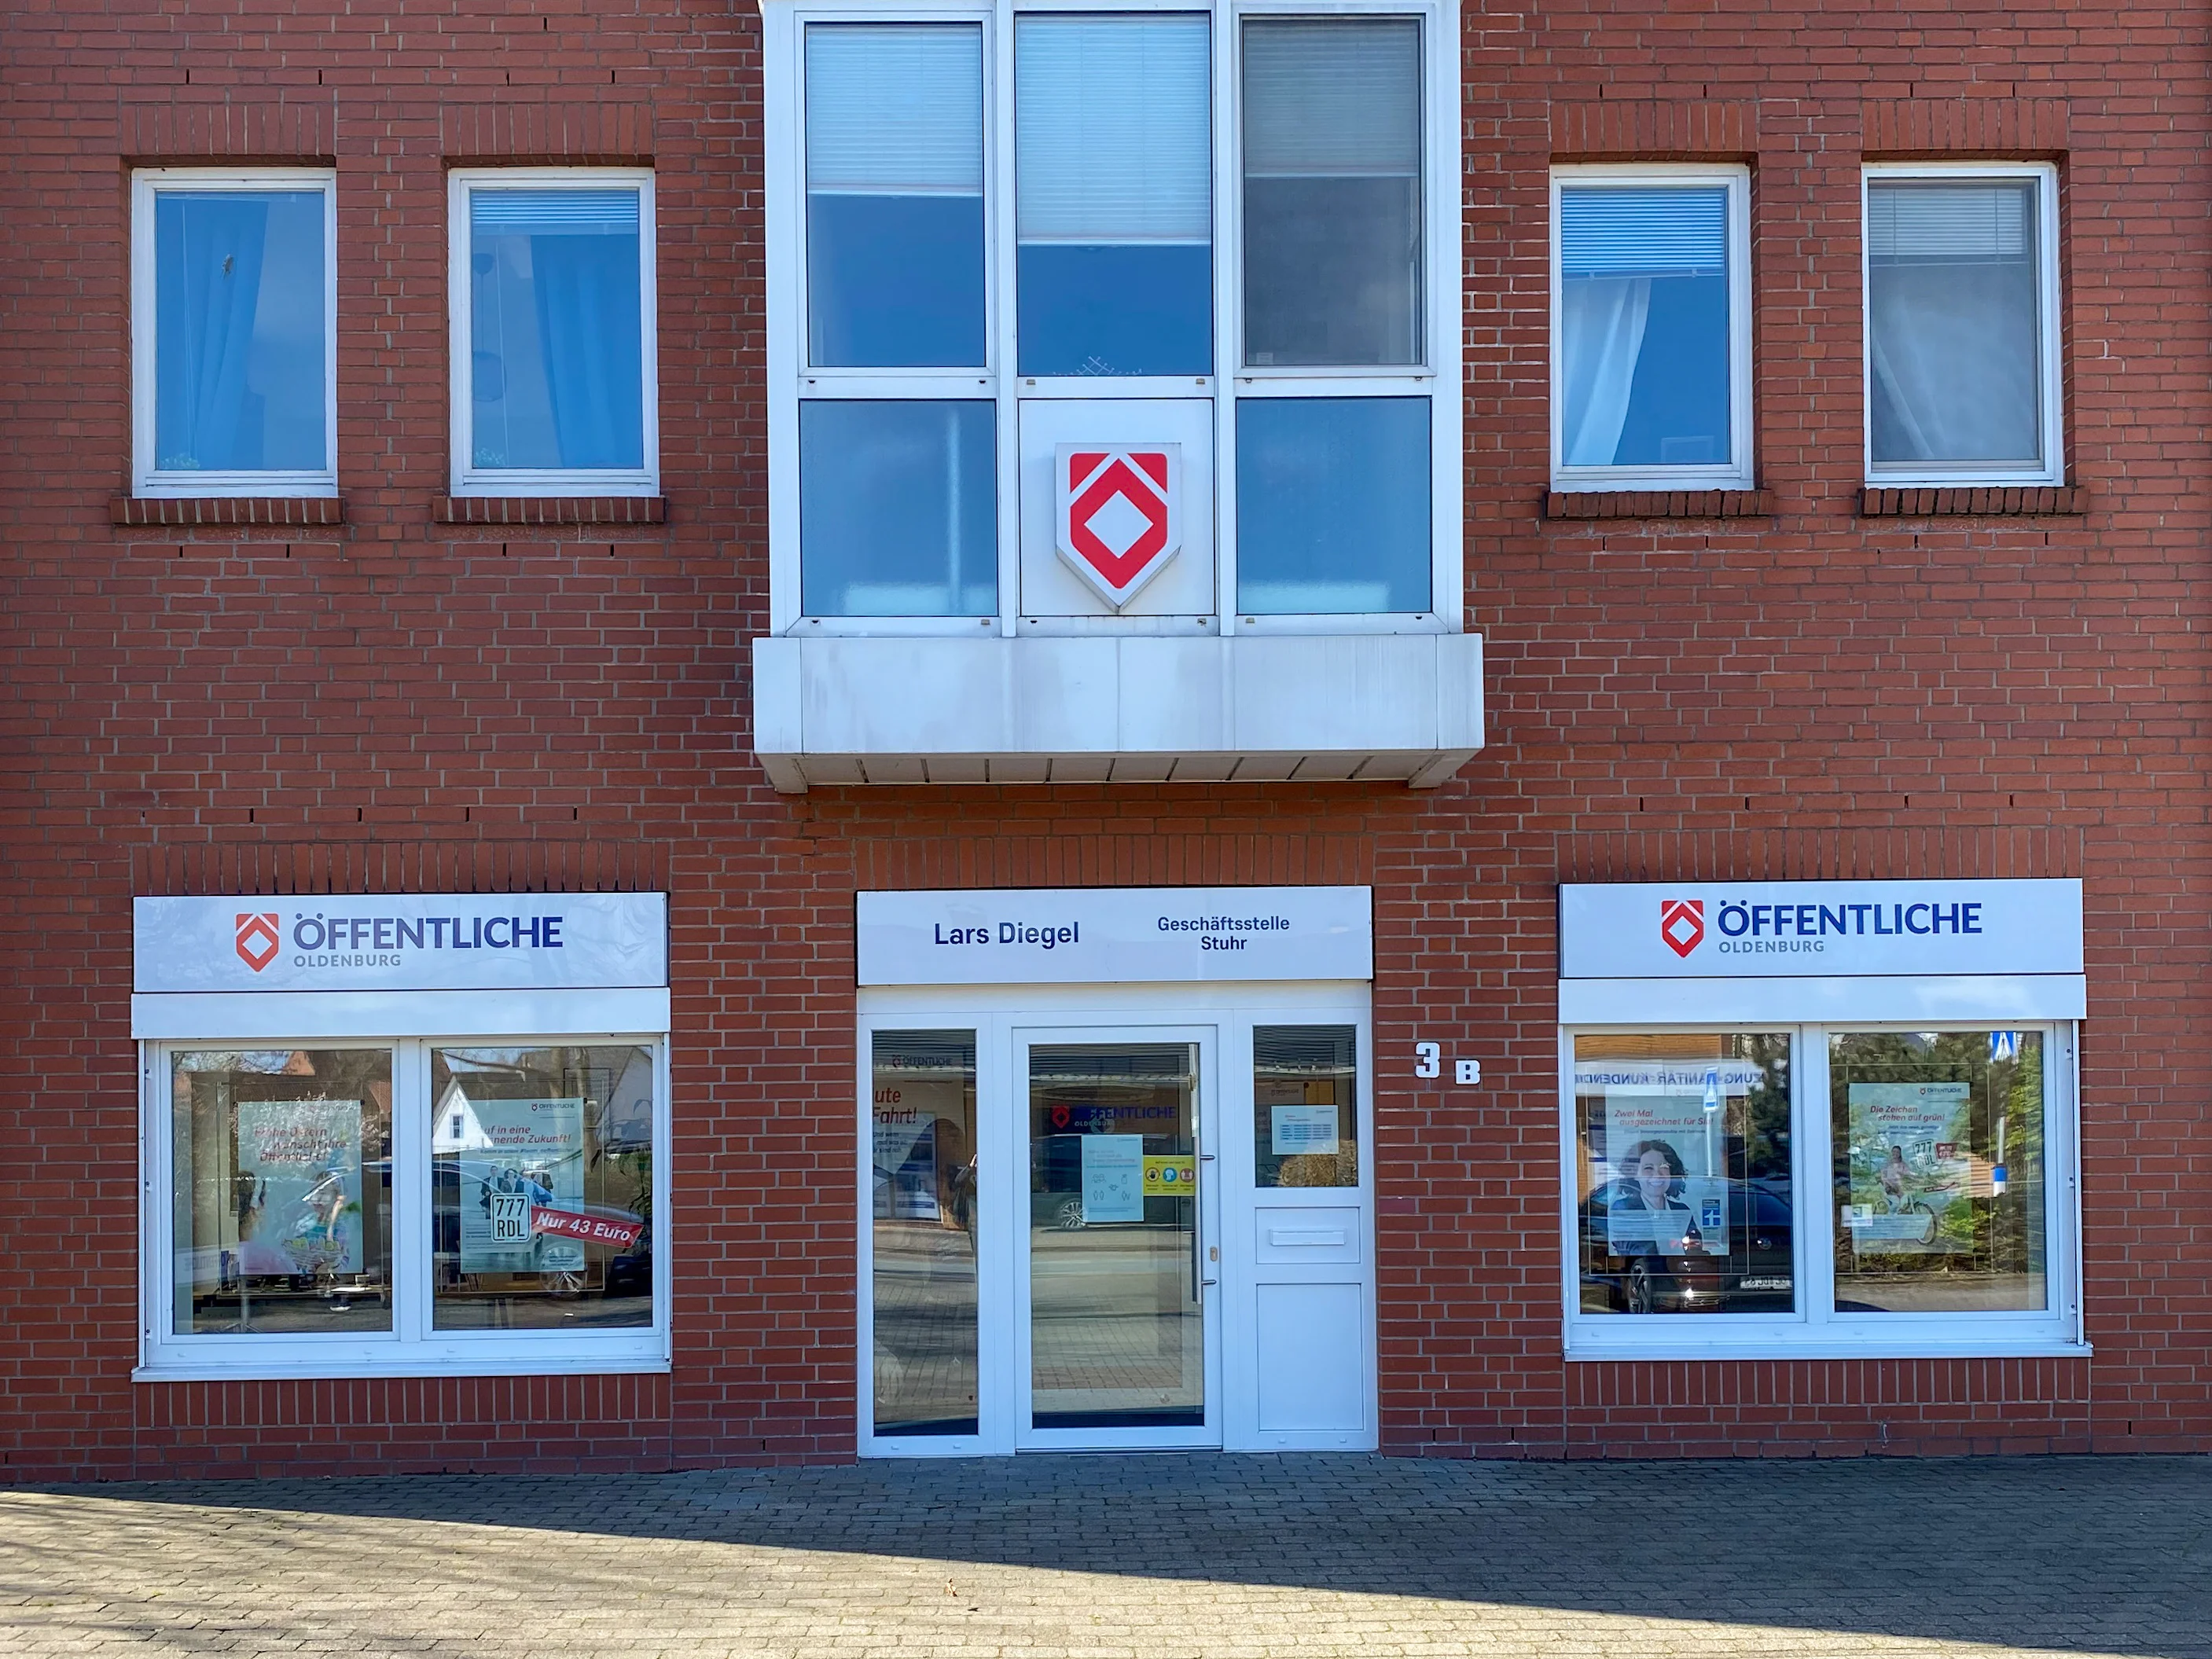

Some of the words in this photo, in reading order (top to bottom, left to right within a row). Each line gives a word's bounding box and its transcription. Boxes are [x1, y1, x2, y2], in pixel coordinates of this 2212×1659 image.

[1157, 916, 1290, 932] Geschäftsstelle
[1718, 900, 1982, 936] ÖFFENTLICHE
[293, 912, 564, 950] ÖFFENTLICHE
[934, 923, 990, 945] Lars
[998, 921, 1079, 949] Diegel
[1200, 935, 1247, 951] Stuhr
[1718, 940, 1824, 953] OLDENBURG
[293, 954, 402, 967] OLDENBURG
[1415, 1041, 1441, 1078] 3
[1454, 1059, 1481, 1085] B
[874, 1087, 902, 1103] ute
[527, 1134, 571, 1144] Zukunft!
[496, 1198, 526, 1217] 777
[497, 1220, 525, 1237] RDL
[535, 1212, 567, 1230] Nur
[569, 1218, 592, 1234] 43
[593, 1224, 631, 1241] Euro
